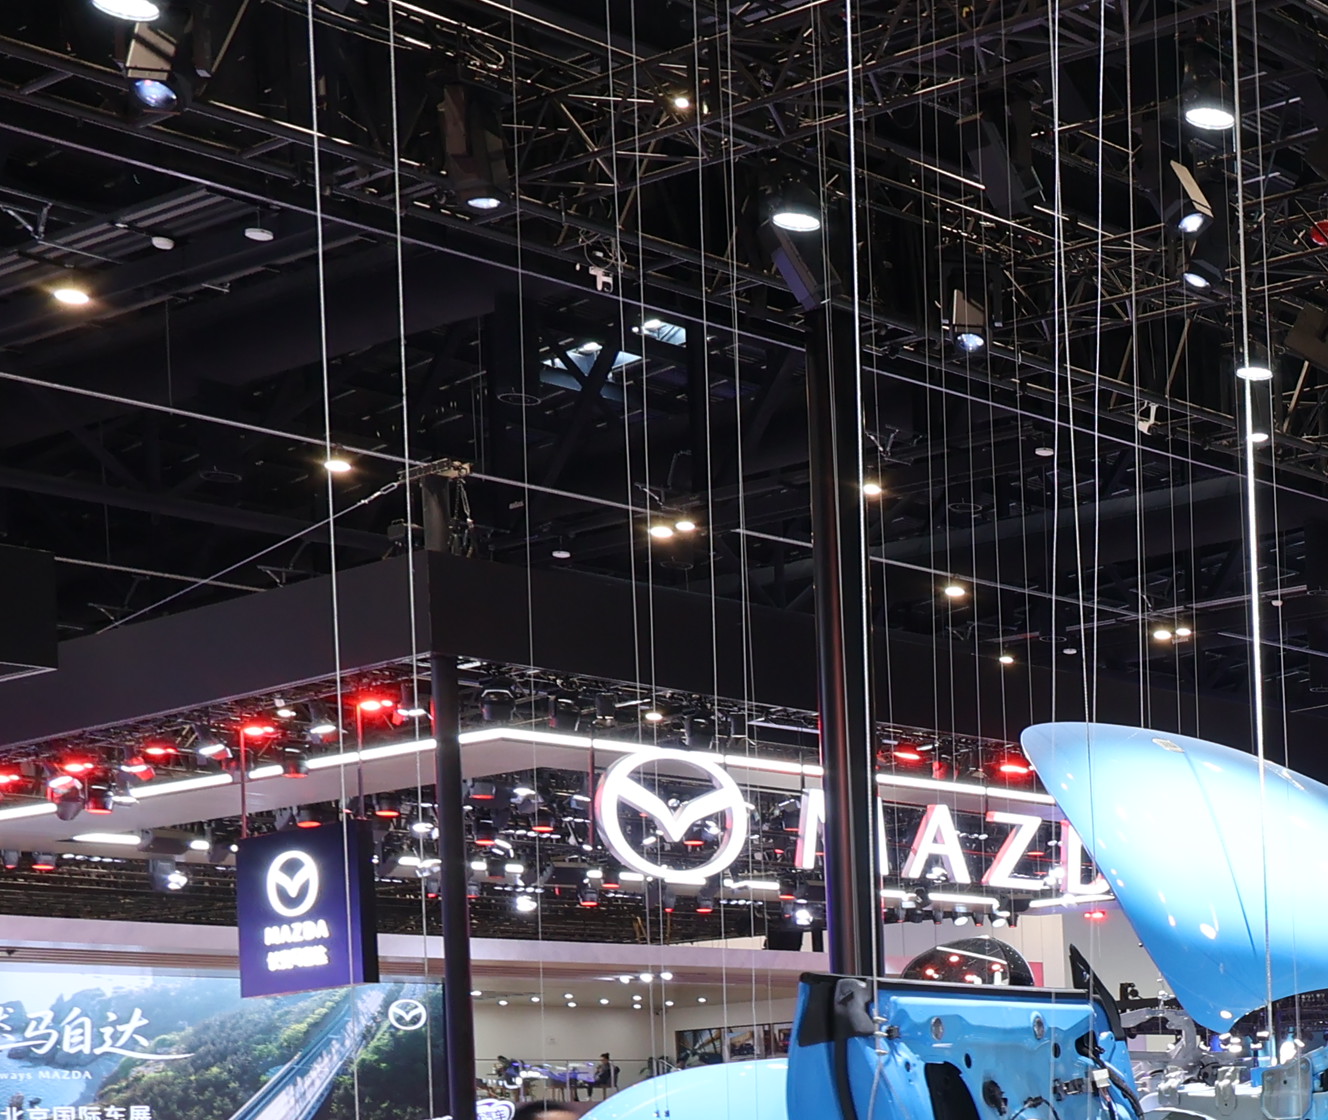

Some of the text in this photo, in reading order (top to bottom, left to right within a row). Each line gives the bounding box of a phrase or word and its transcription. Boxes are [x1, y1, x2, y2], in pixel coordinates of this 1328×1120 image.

[795, 788, 1110, 894] MAZD
[264, 919, 330, 946] MAZDA
[38, 1071, 92, 1080] MAZDA
